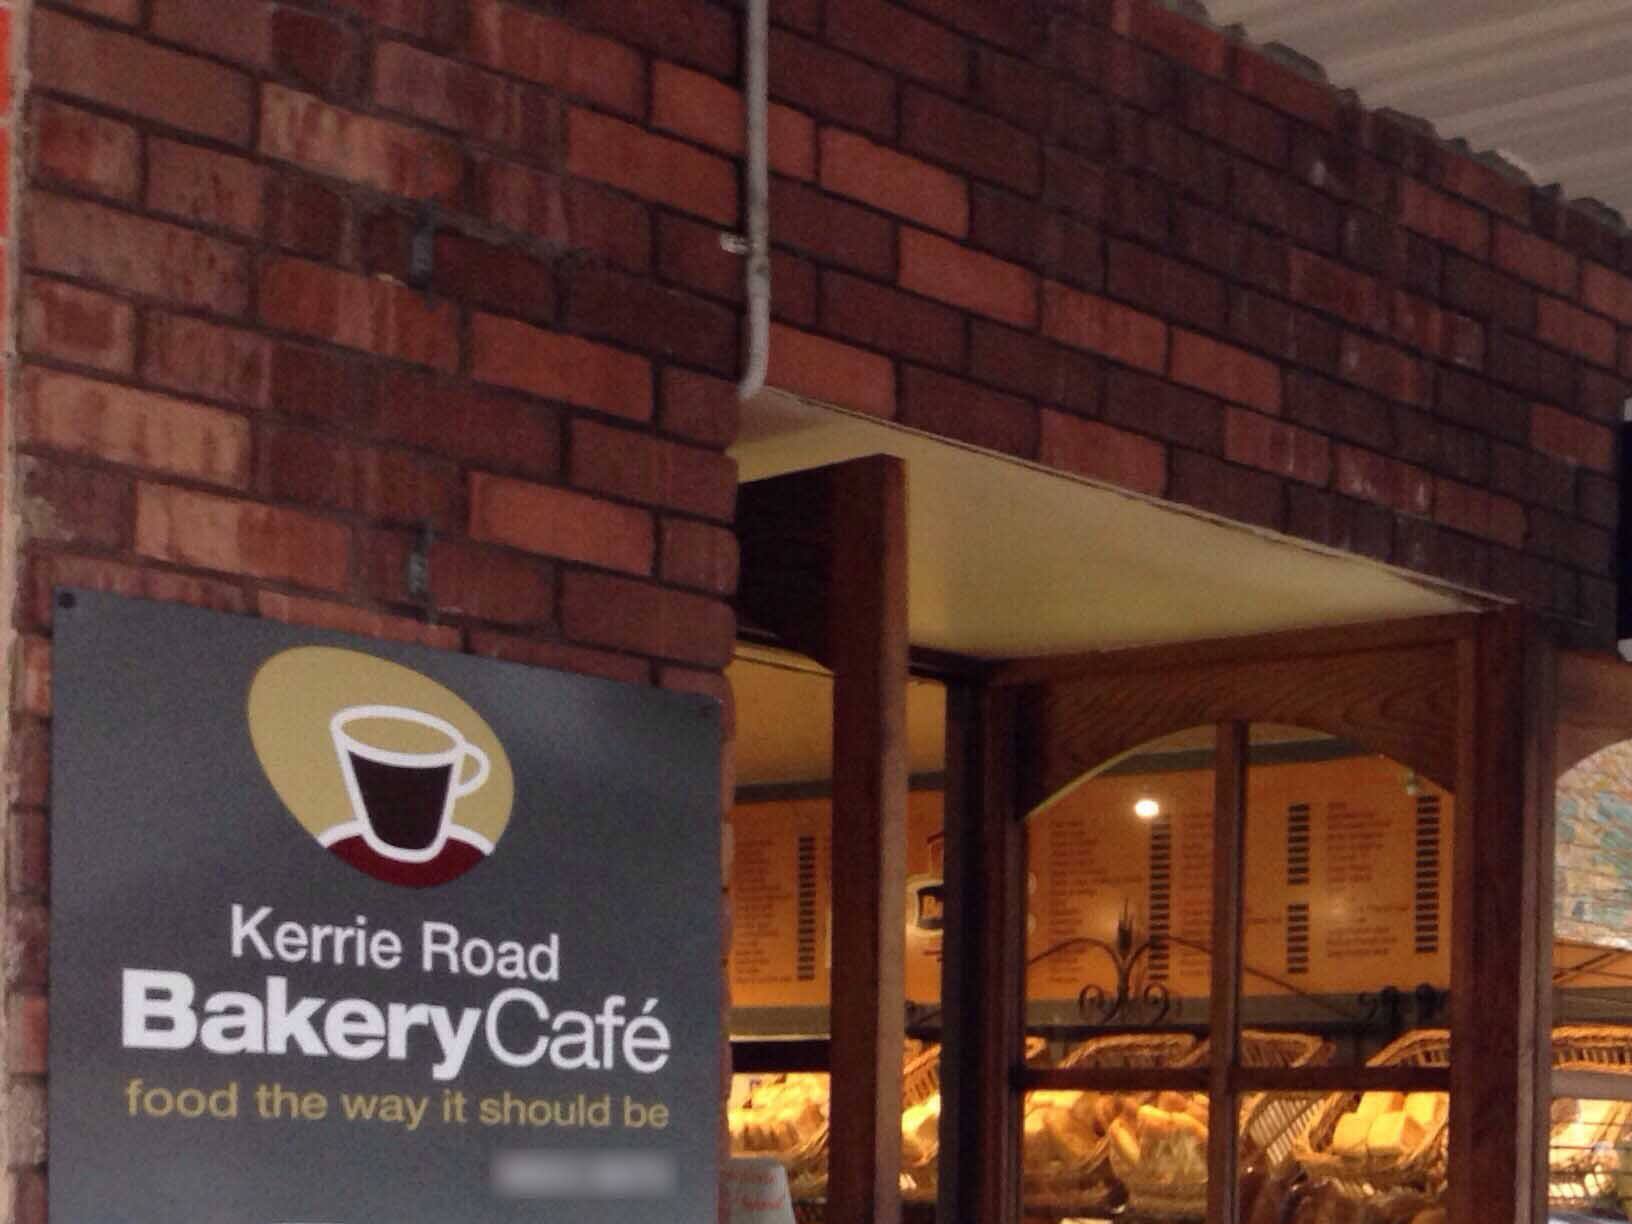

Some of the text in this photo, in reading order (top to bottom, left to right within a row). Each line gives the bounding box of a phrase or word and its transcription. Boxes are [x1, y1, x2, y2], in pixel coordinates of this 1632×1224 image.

[230, 904, 560, 982] Kerrie Road
[121, 967, 671, 1081] BakeryCafé
[125, 1076, 670, 1131] food the way it should be
